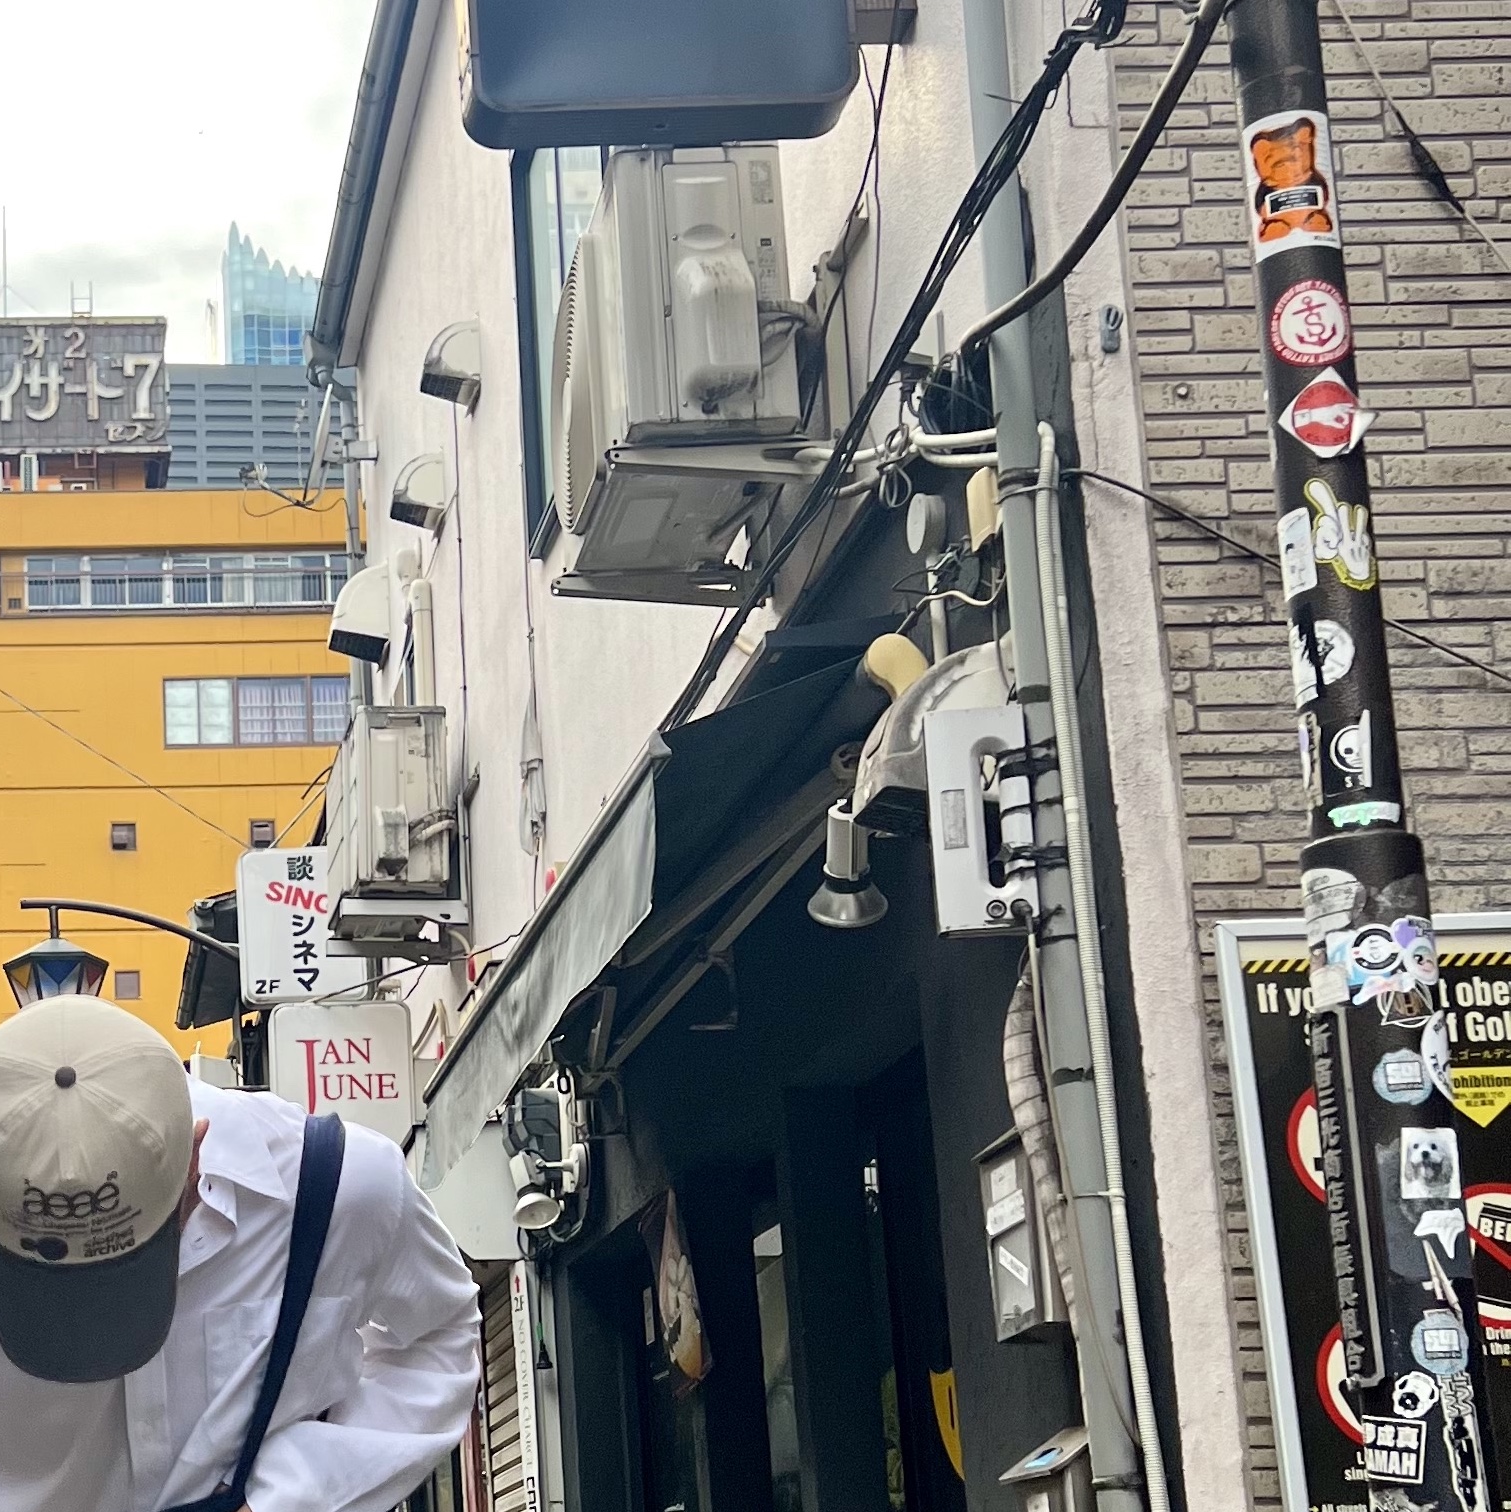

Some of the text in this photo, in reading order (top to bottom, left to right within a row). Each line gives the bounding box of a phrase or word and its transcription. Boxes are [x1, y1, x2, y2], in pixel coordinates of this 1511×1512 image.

[104, 420, 168, 442] セブン
[286, 854, 314, 882] 談
[291, 914, 319, 992] シネマ
[255, 979, 281, 995] 2F
[1256, 982, 1279, 1014] If
[1284, 986, 1316, 1017] yo
[1455, 976, 1511, 1008] obe
[84, 1238, 136, 1258] archive
